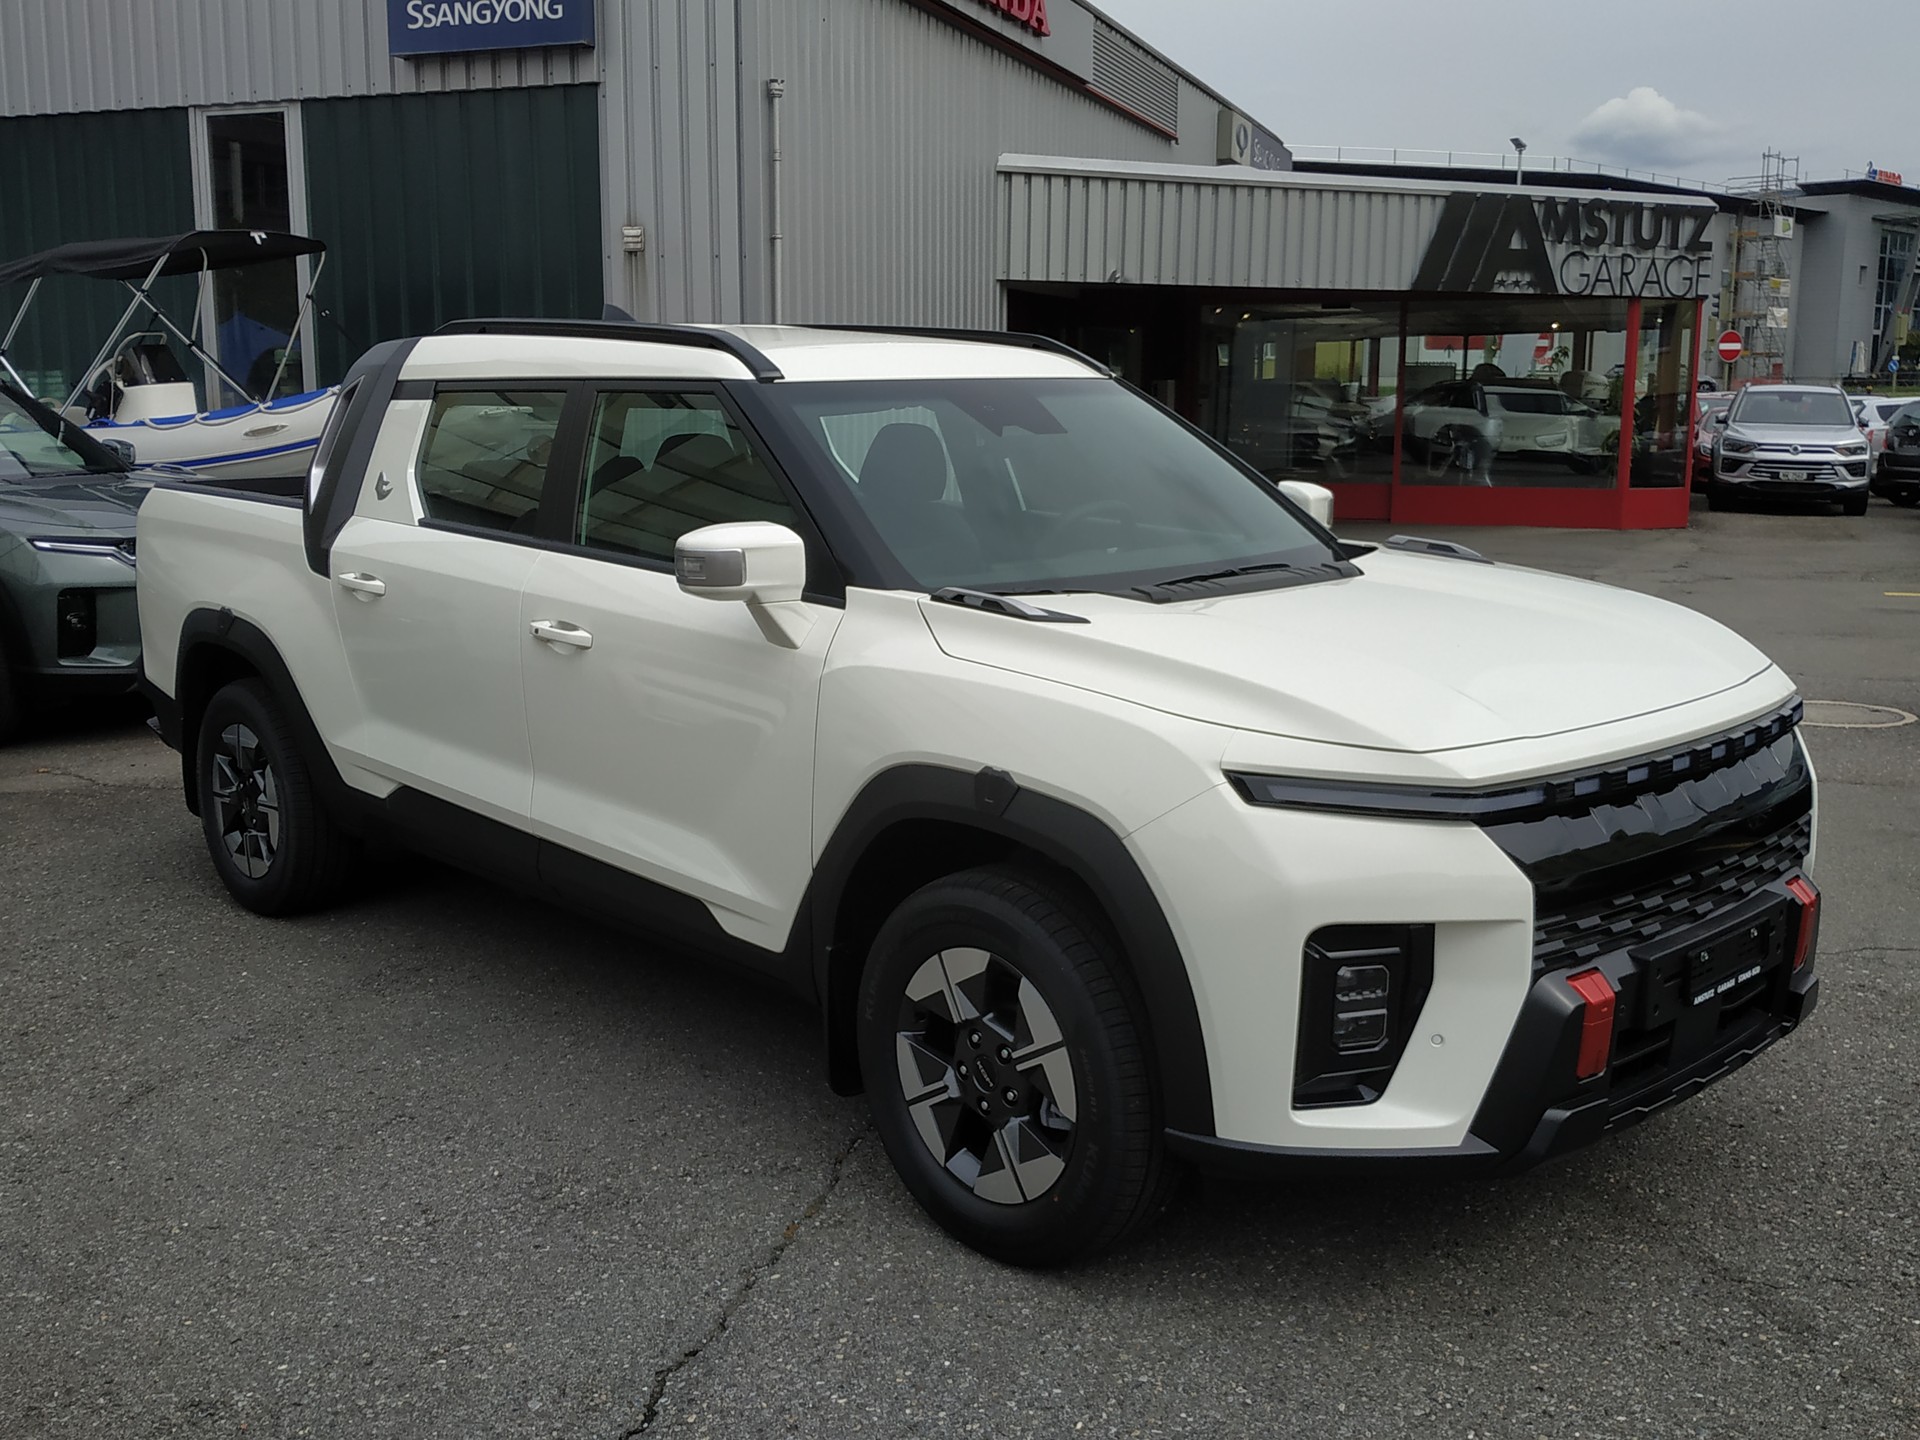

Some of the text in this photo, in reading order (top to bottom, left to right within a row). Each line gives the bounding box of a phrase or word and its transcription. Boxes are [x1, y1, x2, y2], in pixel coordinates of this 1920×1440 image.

[406, 0, 563, 29] SSANGYONG
[1468, 193, 1714, 295] AMSTUTZ
[1558, 250, 1713, 298] GARAGE
[1717, 978, 1736, 993] GARAGE
